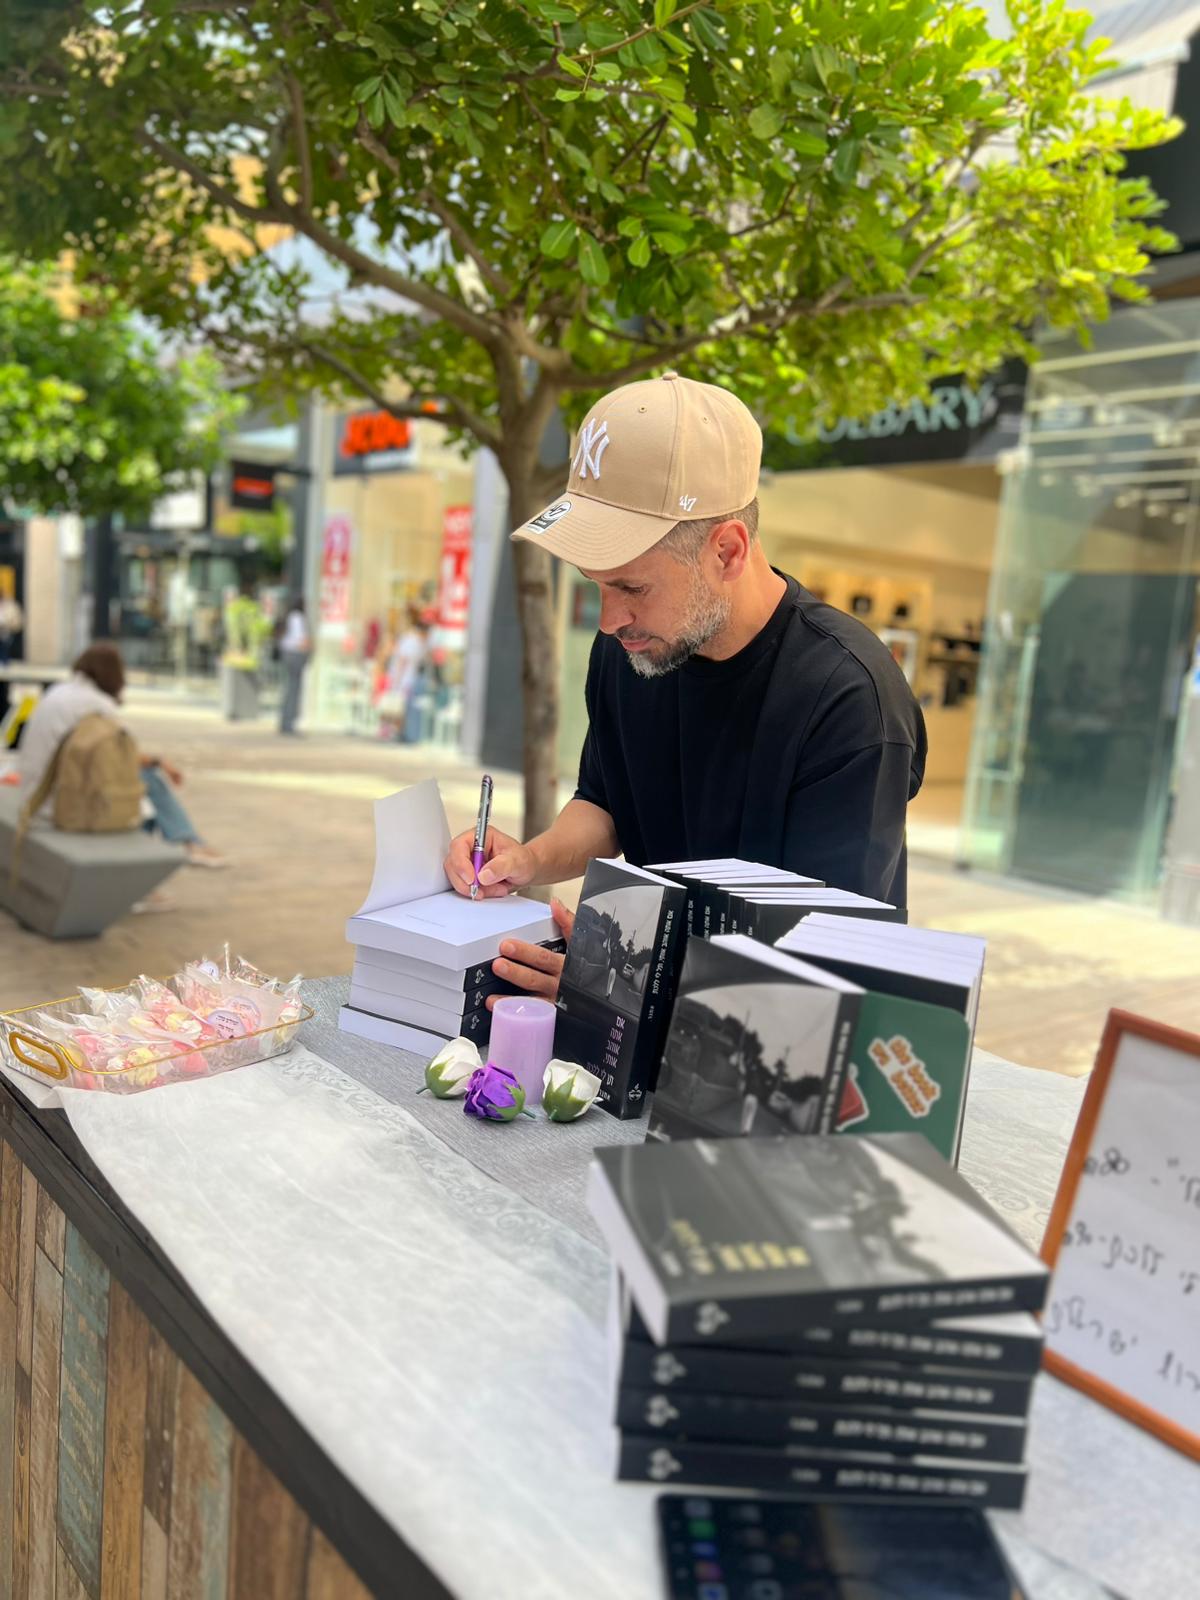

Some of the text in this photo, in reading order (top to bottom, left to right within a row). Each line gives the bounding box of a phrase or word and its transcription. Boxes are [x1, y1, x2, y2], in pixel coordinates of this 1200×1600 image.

[573, 417, 610, 480] NY
[616, 1016, 625, 1029] אם
[610, 1028, 622, 1042] אתה
[606, 1040, 620, 1055] אוהב
